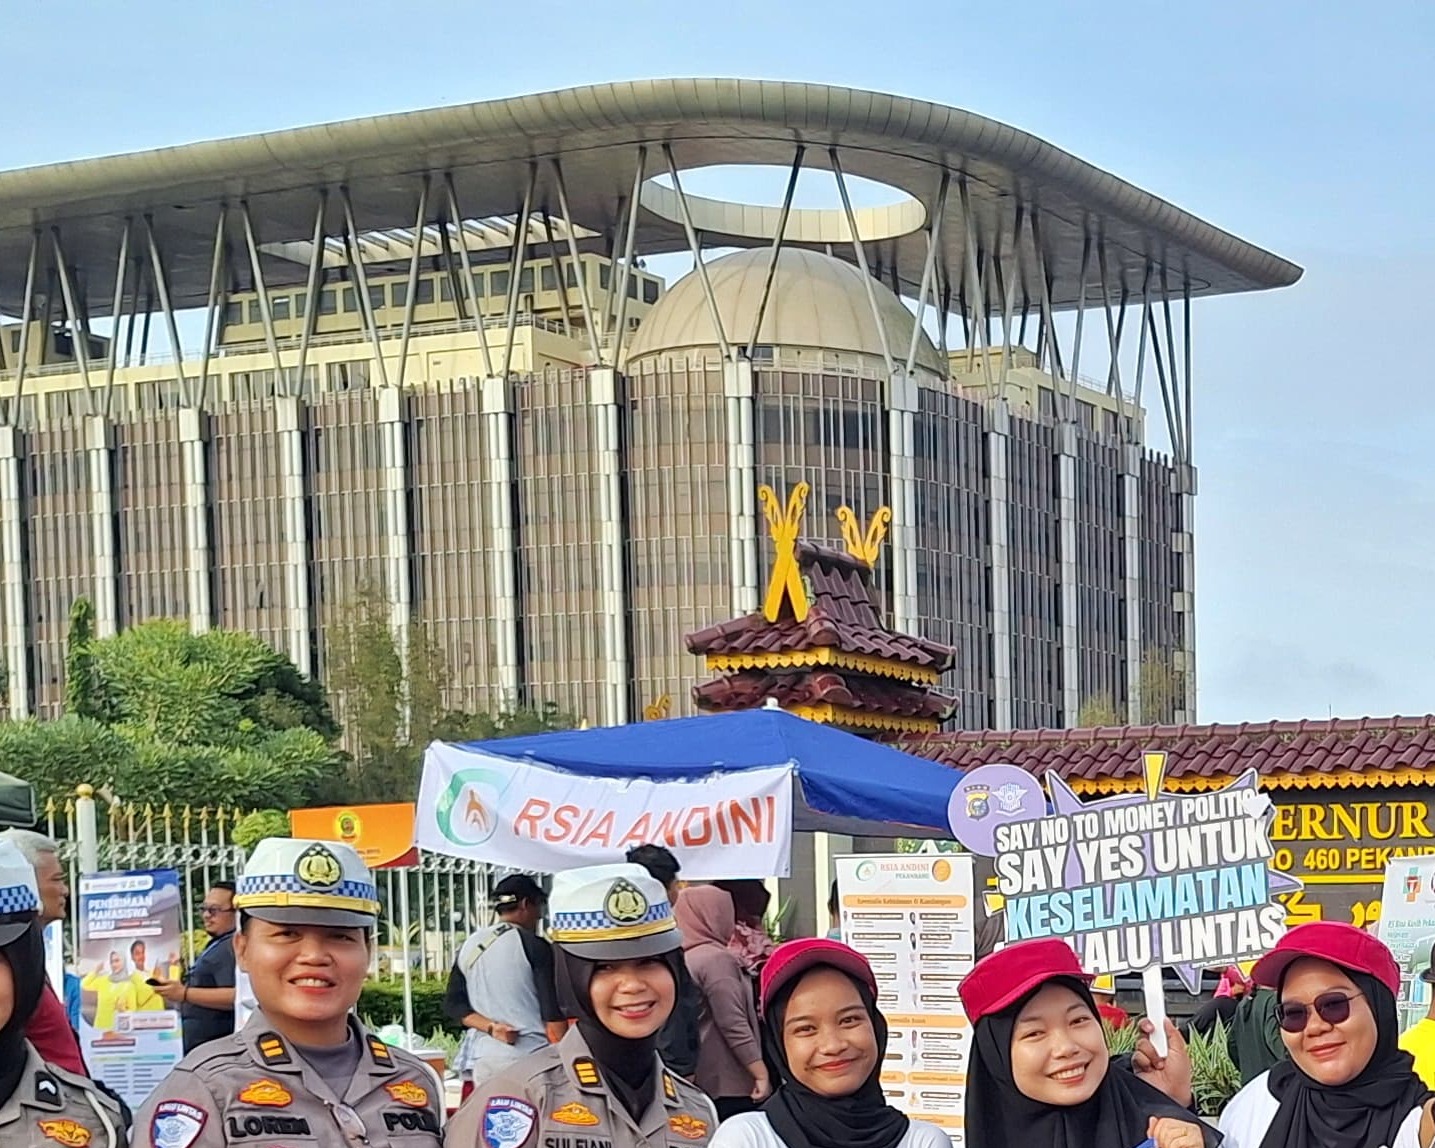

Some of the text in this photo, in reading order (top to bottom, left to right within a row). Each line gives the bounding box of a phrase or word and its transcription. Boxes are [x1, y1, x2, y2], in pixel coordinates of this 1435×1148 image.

[513, 795, 775, 847] RSIA ANDINI
[996, 824, 1037, 850] SAY
[1041, 818, 1069, 845] NO
[1076, 812, 1099, 840] TO
[1104, 801, 1179, 837] MONEY
[1270, 802, 1434, 840] ERNUR
[999, 817, 1270, 895] SAY YES UNTUK
[1303, 848, 1340, 870] 460
[1007, 862, 1269, 942] KESELAMATAN
[1160, 906, 1285, 964] LINTAS
